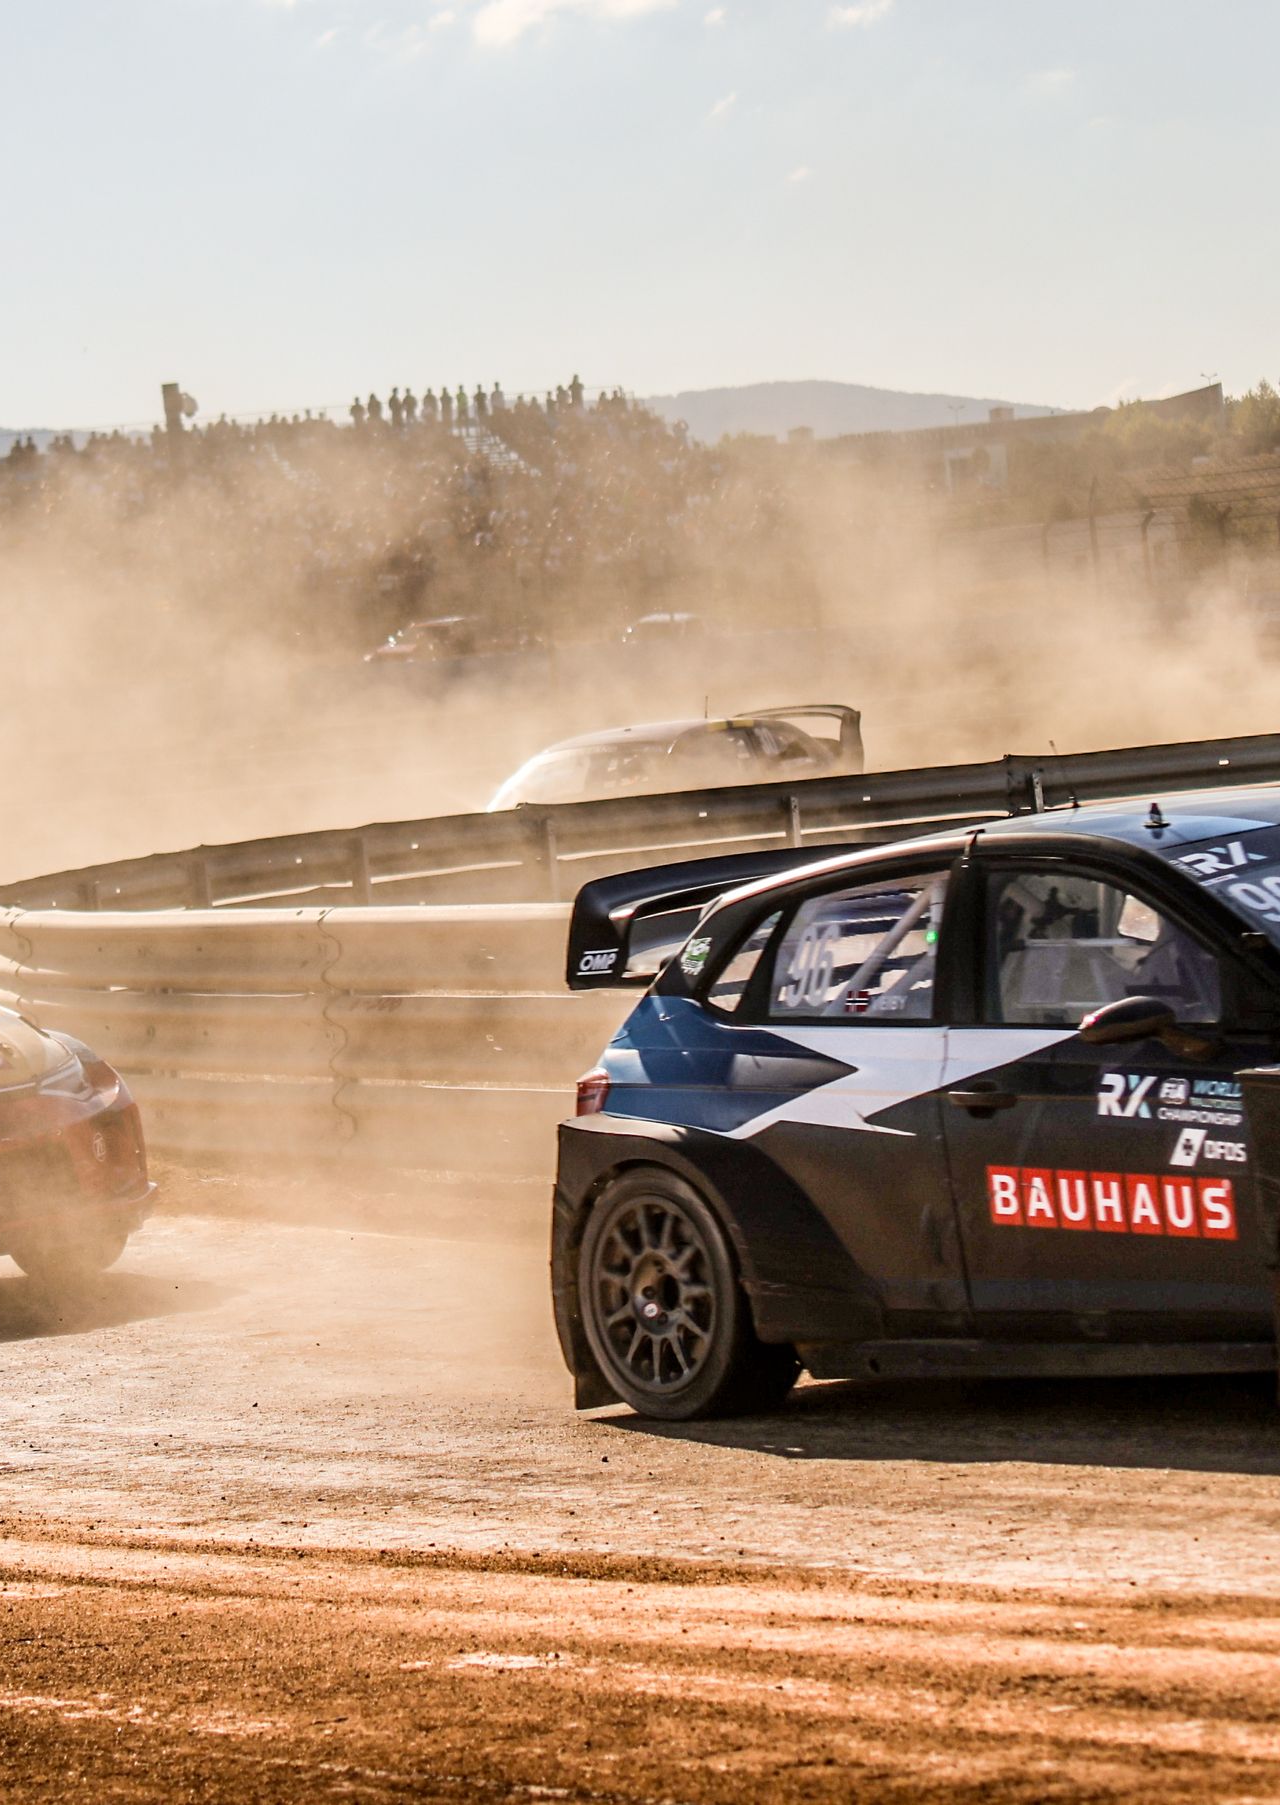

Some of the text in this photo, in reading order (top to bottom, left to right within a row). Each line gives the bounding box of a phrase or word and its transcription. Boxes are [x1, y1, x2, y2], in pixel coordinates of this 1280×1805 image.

[1178, 841, 1268, 875] RX
[578, 953, 618, 971] OMP
[789, 923, 841, 1009] 96
[1098, 1073, 1158, 1118] RX
[1204, 1140, 1247, 1162] DFDS
[991, 1174, 1232, 1229] BAUHAUS
